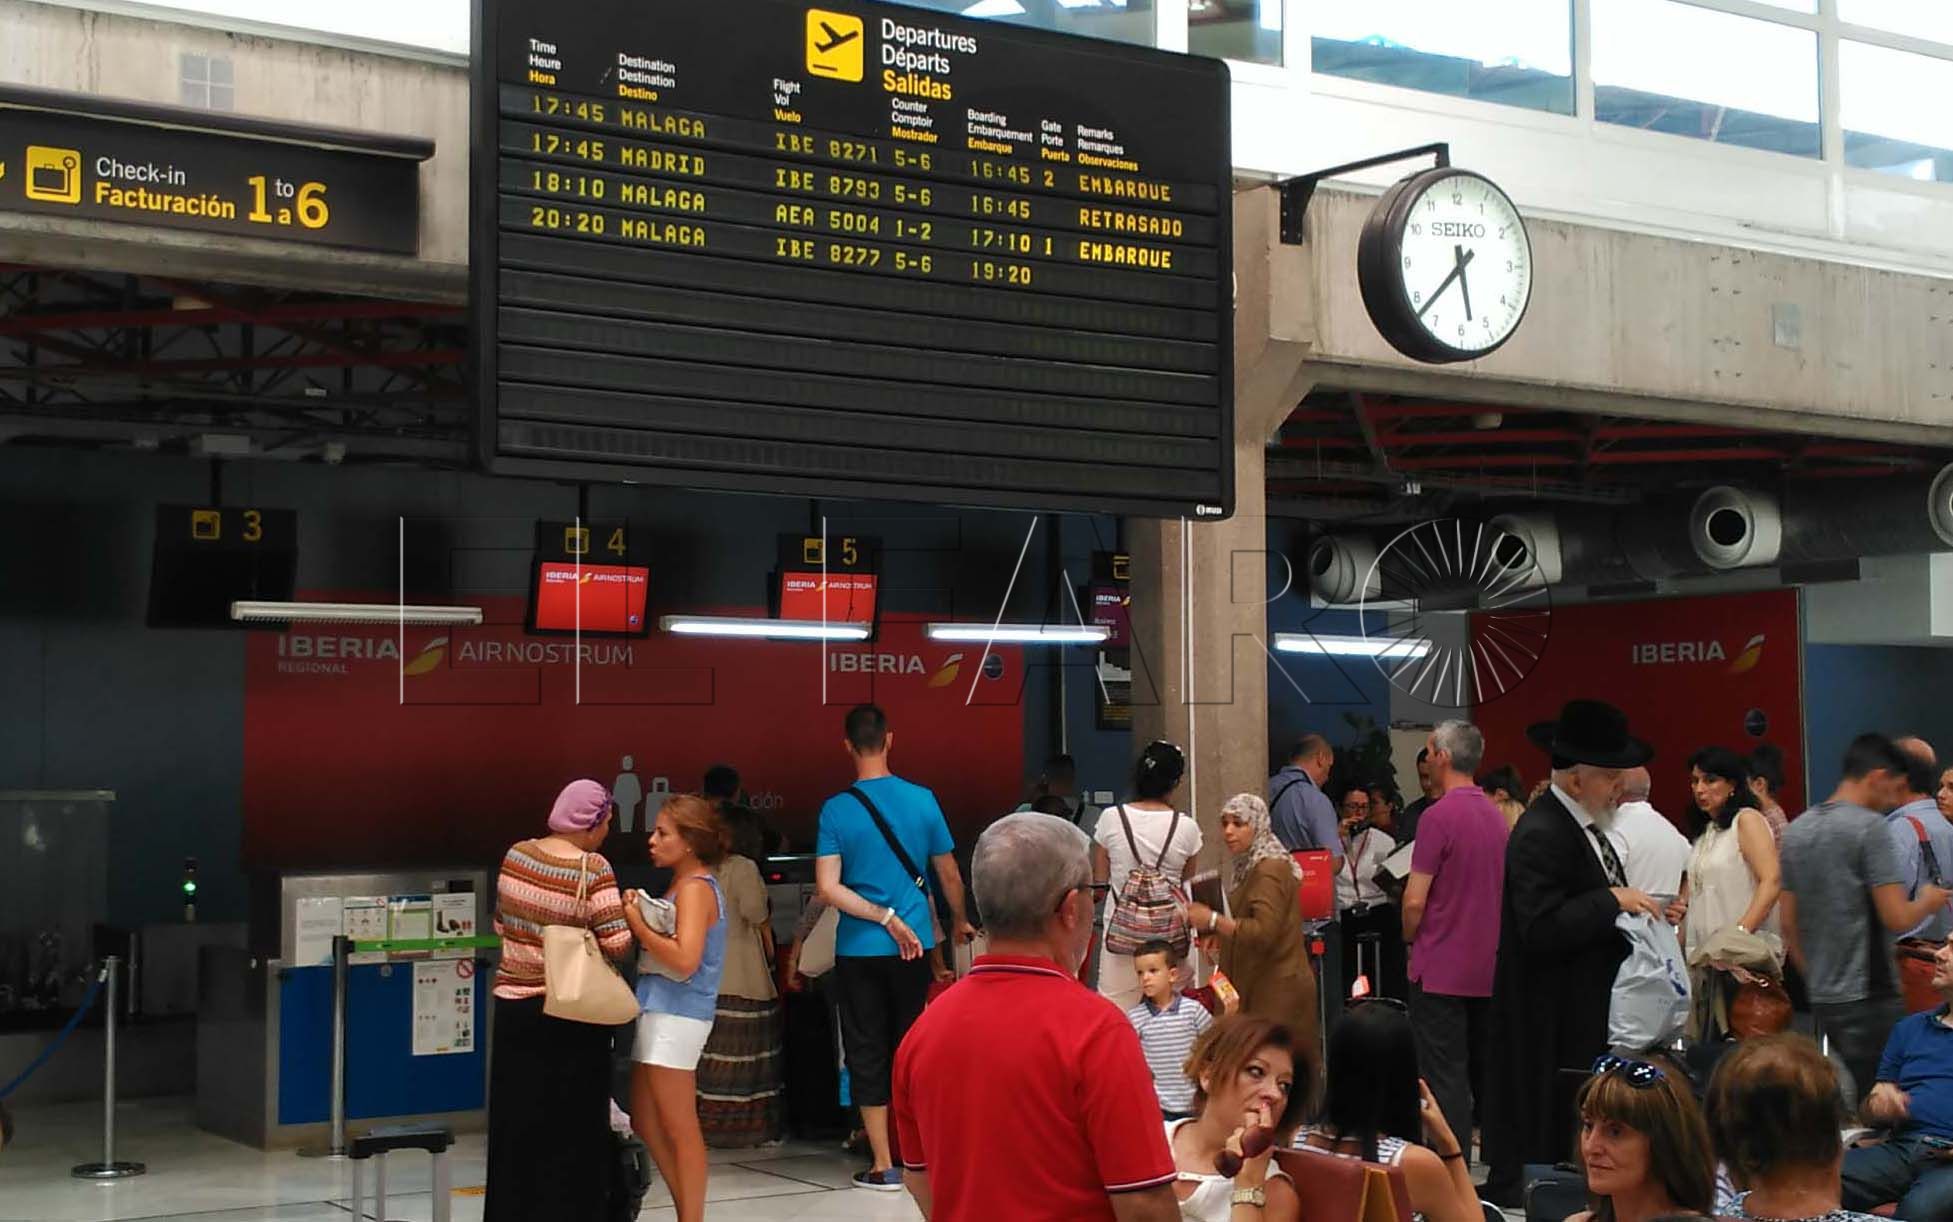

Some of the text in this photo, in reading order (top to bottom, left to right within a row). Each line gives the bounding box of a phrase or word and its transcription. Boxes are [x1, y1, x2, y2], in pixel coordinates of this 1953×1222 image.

[882, 18, 977, 54] Departures
[529, 39, 557, 55] Time
[529, 54, 562, 70] Heure
[619, 53, 676, 74] Destination
[882, 43, 950, 75] Départs
[529, 69, 556, 86] Hora
[619, 68, 676, 89] Destination
[884, 69, 951, 100] Salidas
[619, 84, 658, 102] Destino
[773, 78, 801, 95] Flight
[774, 93, 790, 106] Vol
[892, 97, 928, 114] Counter
[774, 109, 801, 124] Vuelo
[892, 111, 933, 128] Comptoir
[967, 108, 1007, 127] Boarding
[892, 126, 938, 144] Mostrador
[967, 122, 1033, 143] Embarquement
[1041, 120, 1062, 134] Gate
[1077, 124, 1114, 141] Remarks
[533, 95, 1172, 202] 17:45 MALAGA IBE 8271 5-6 16:45 2 EMBARQUE
[967, 137, 1013, 155] Embarque
[1041, 133, 1064, 148] Porte
[1077, 138, 1124, 156] Remarques
[1041, 147, 1070, 163] Puerta
[1078, 153, 1139, 173] Observaciones
[96, 157, 186, 187] Check-in
[532, 132, 1183, 237] 17:45 MADRID IBE 8793 5-6 16:45 RETRASADO
[95, 183, 236, 220] Facturación
[248, 175, 330, 230] 1 to 6
[1427, 200, 1436, 212] 11
[1452, 193, 1463, 206] 12
[278, 206, 292, 226] a
[1479, 203, 1484, 214] 1
[532, 170, 1172, 269] 18:10 MALAGA AEA 5004 1-2 17:10 1 EMBARQUE
[1411, 223, 1422, 236] 10
[1431, 222, 1486, 238] SEIKO
[1498, 227, 1505, 239] 2
[531, 207, 1031, 285] 20:20 MALAGA IBE 8277 5-6 19:20
[1404, 256, 1412, 269] 9
[1506, 260, 1513, 273] 3
[1413, 291, 1421, 303] 8
[1499, 294, 1506, 305] 4
[1432, 314, 1440, 327] 7
[1482, 316, 1489, 328] 5
[1458, 323, 1465, 336] 6
[242, 510, 262, 541] 3
[607, 528, 626, 556] 4
[842, 538, 857, 566] 5
[546, 571, 578, 580] IBERIA
[787, 580, 816, 588] IBERIA
[278, 634, 400, 660] IBERIA
[1632, 640, 1727, 665] IBERIA
[278, 661, 349, 674] REGIONAL
[830, 652, 927, 675] IBERIA
